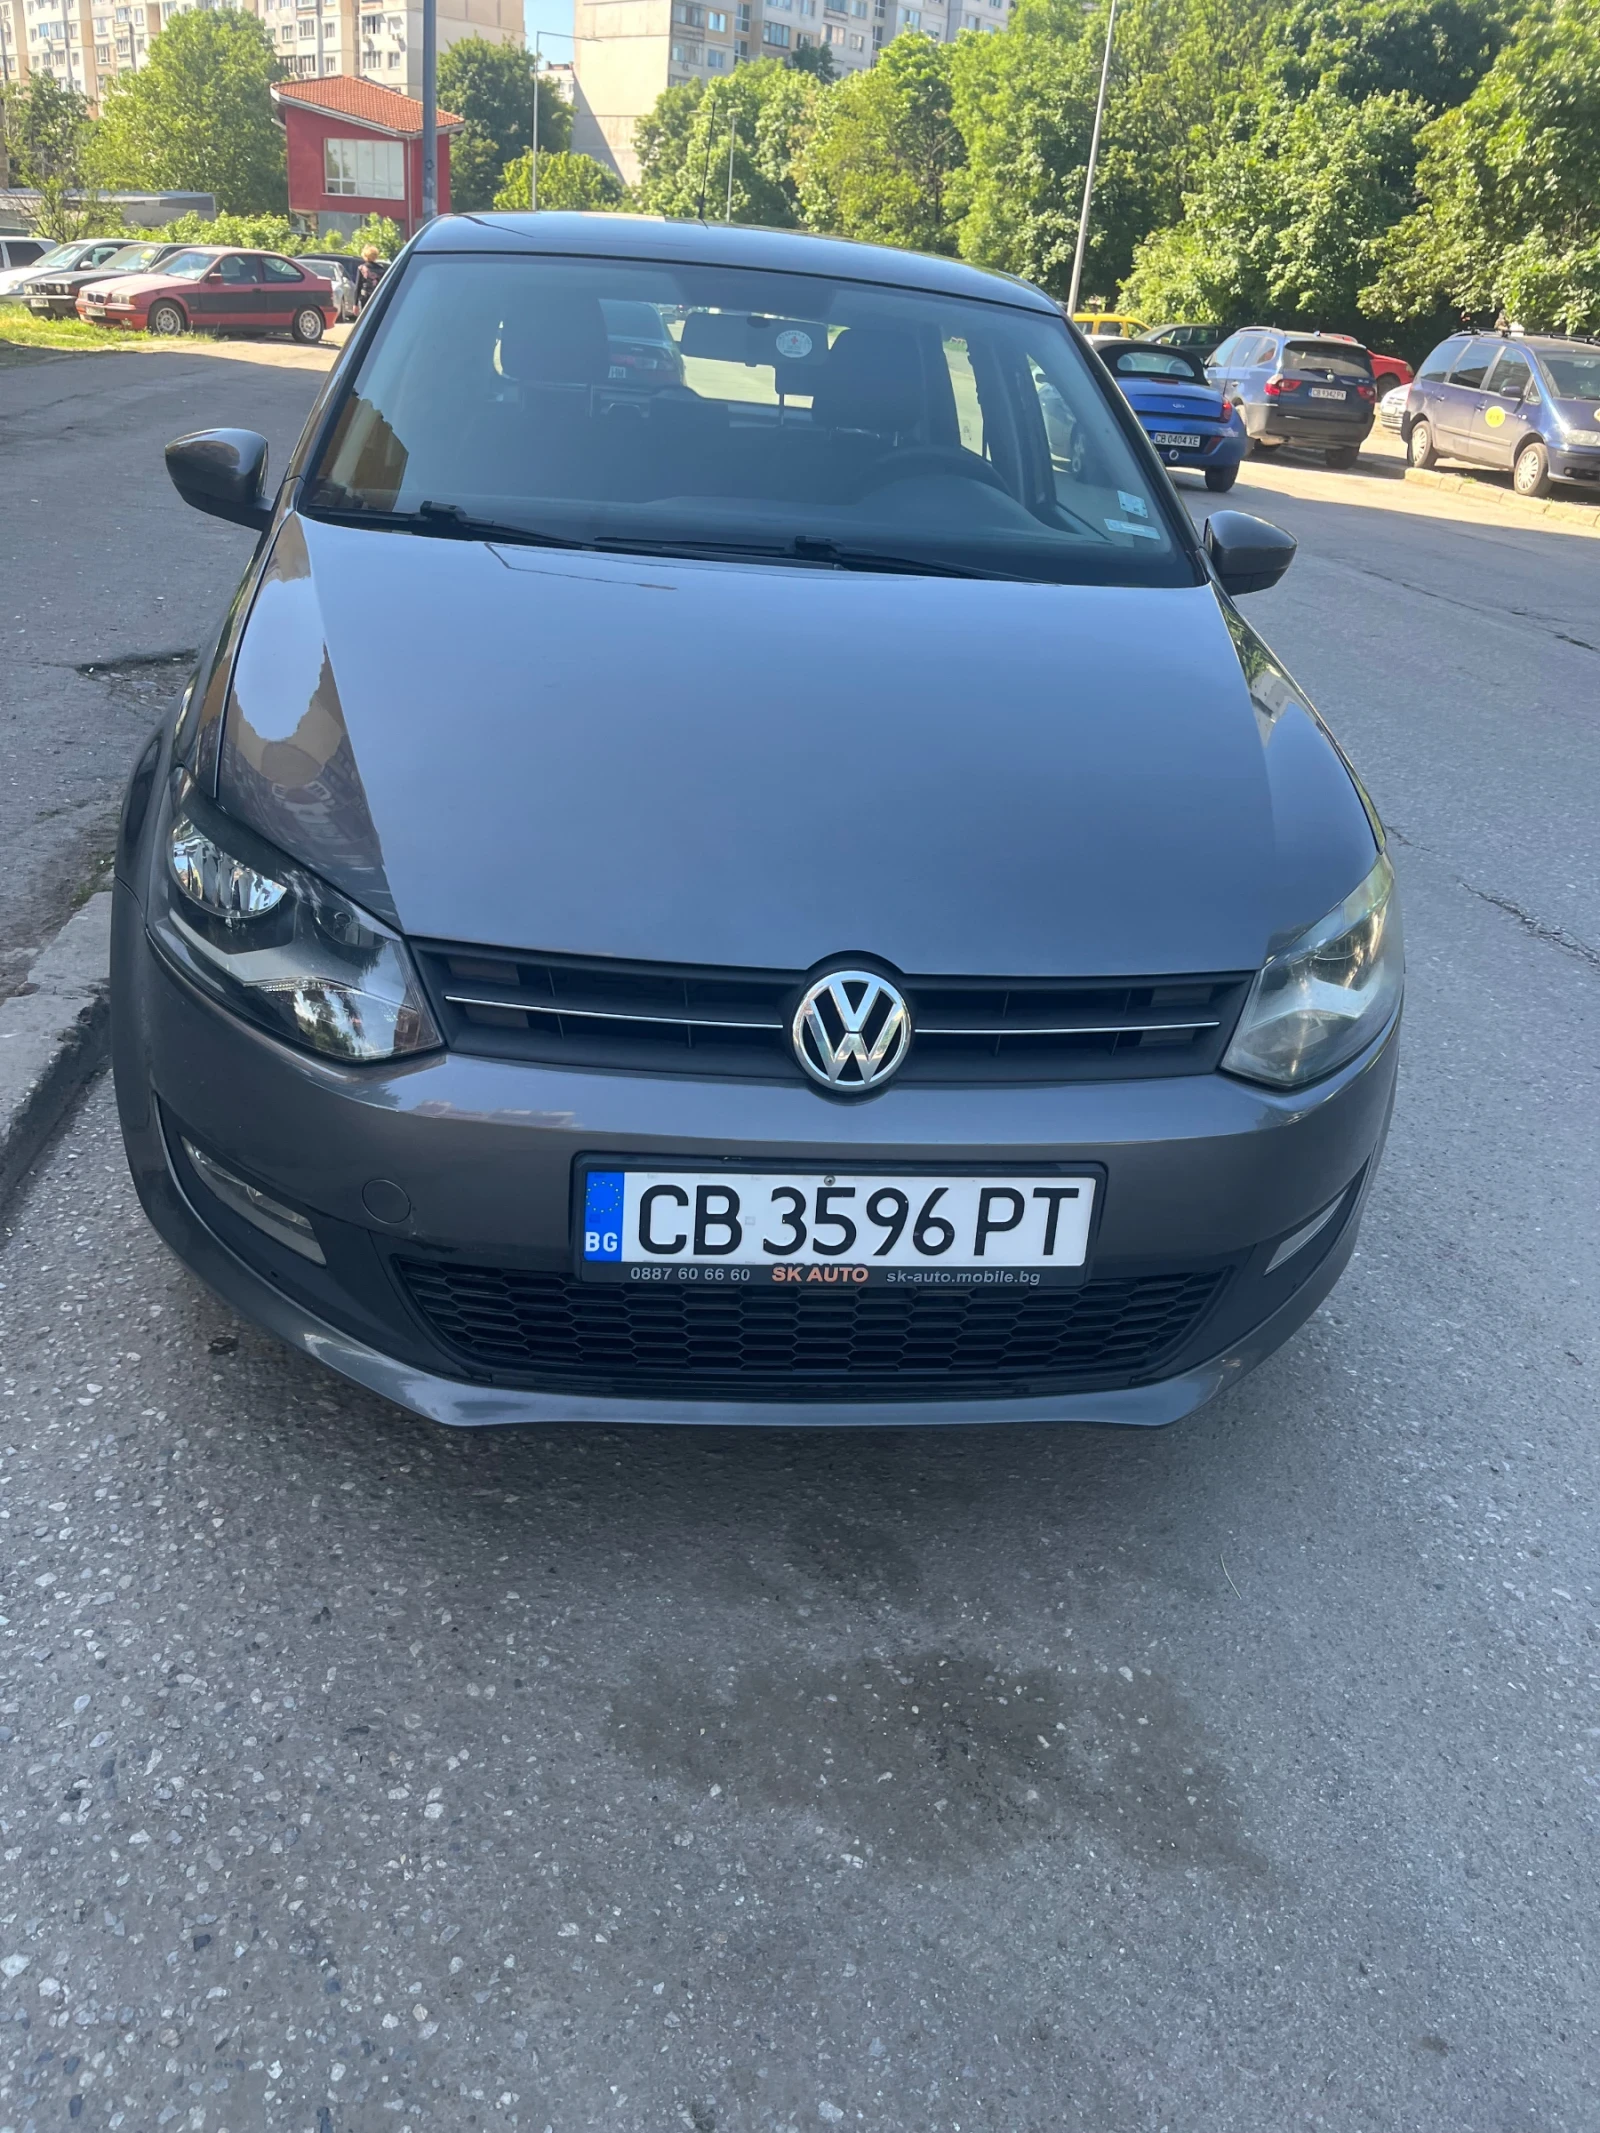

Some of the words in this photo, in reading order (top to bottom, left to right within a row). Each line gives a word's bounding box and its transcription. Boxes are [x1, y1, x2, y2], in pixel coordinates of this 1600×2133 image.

[1156, 434, 1166, 443] CB
[1168, 435, 1187, 444] 0404
[1188, 436, 1199, 445] XE
[639, 1184, 742, 1255] CB
[763, 1186, 956, 1256] 3596
[973, 1187, 1080, 1257] PT
[585, 1231, 618, 1252] BG
[630, 1267, 672, 1280] 0887
[678, 1267, 698, 1280] 60
[704, 1268, 725, 1281] 66
[730, 1268, 750, 1281] 60
[772, 1266, 804, 1282] SK
[806, 1266, 869, 1283] AUTO
[886, 1270, 1041, 1286] sk-auto.mobile.bg
